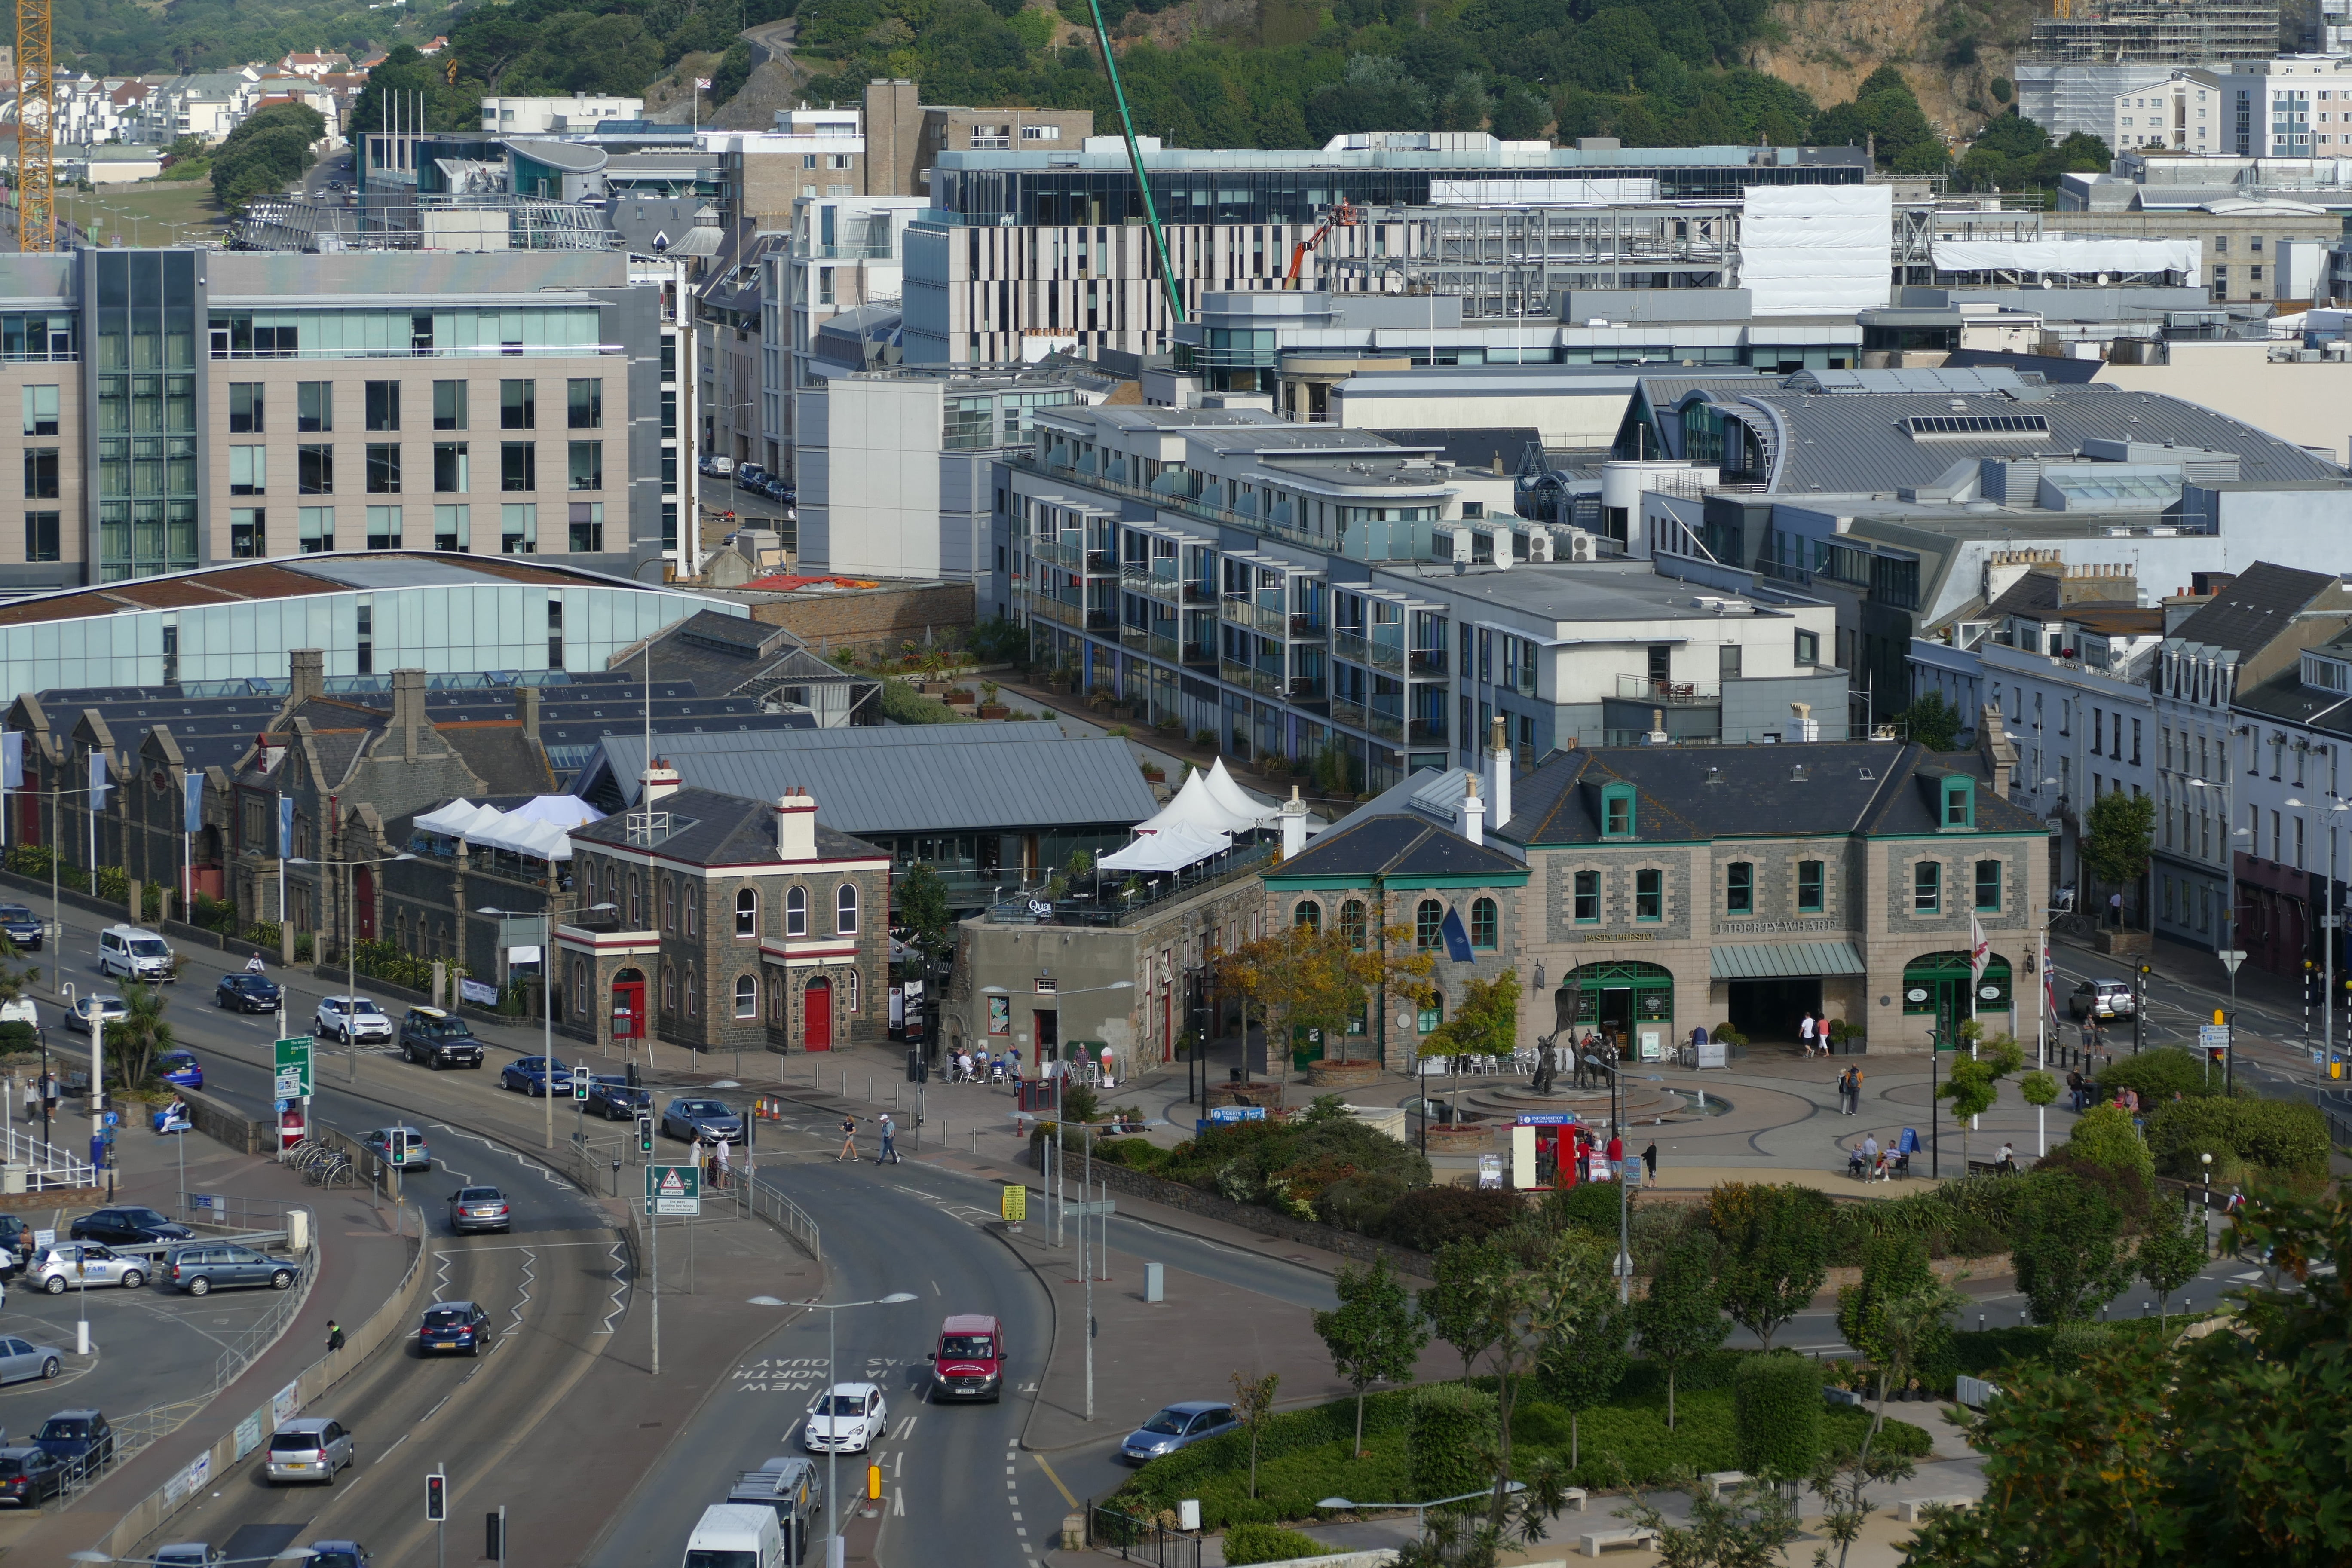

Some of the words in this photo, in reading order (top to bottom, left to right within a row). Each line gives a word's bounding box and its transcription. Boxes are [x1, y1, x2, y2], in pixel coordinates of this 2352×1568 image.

[1719, 922, 1779, 934] LIBERTY
[1783, 921, 1836, 932] WHARF
[753, 1359, 830, 1367] QUAY
[732, 1370, 829, 1379] NORTH
[737, 1382, 812, 1391] NEW
